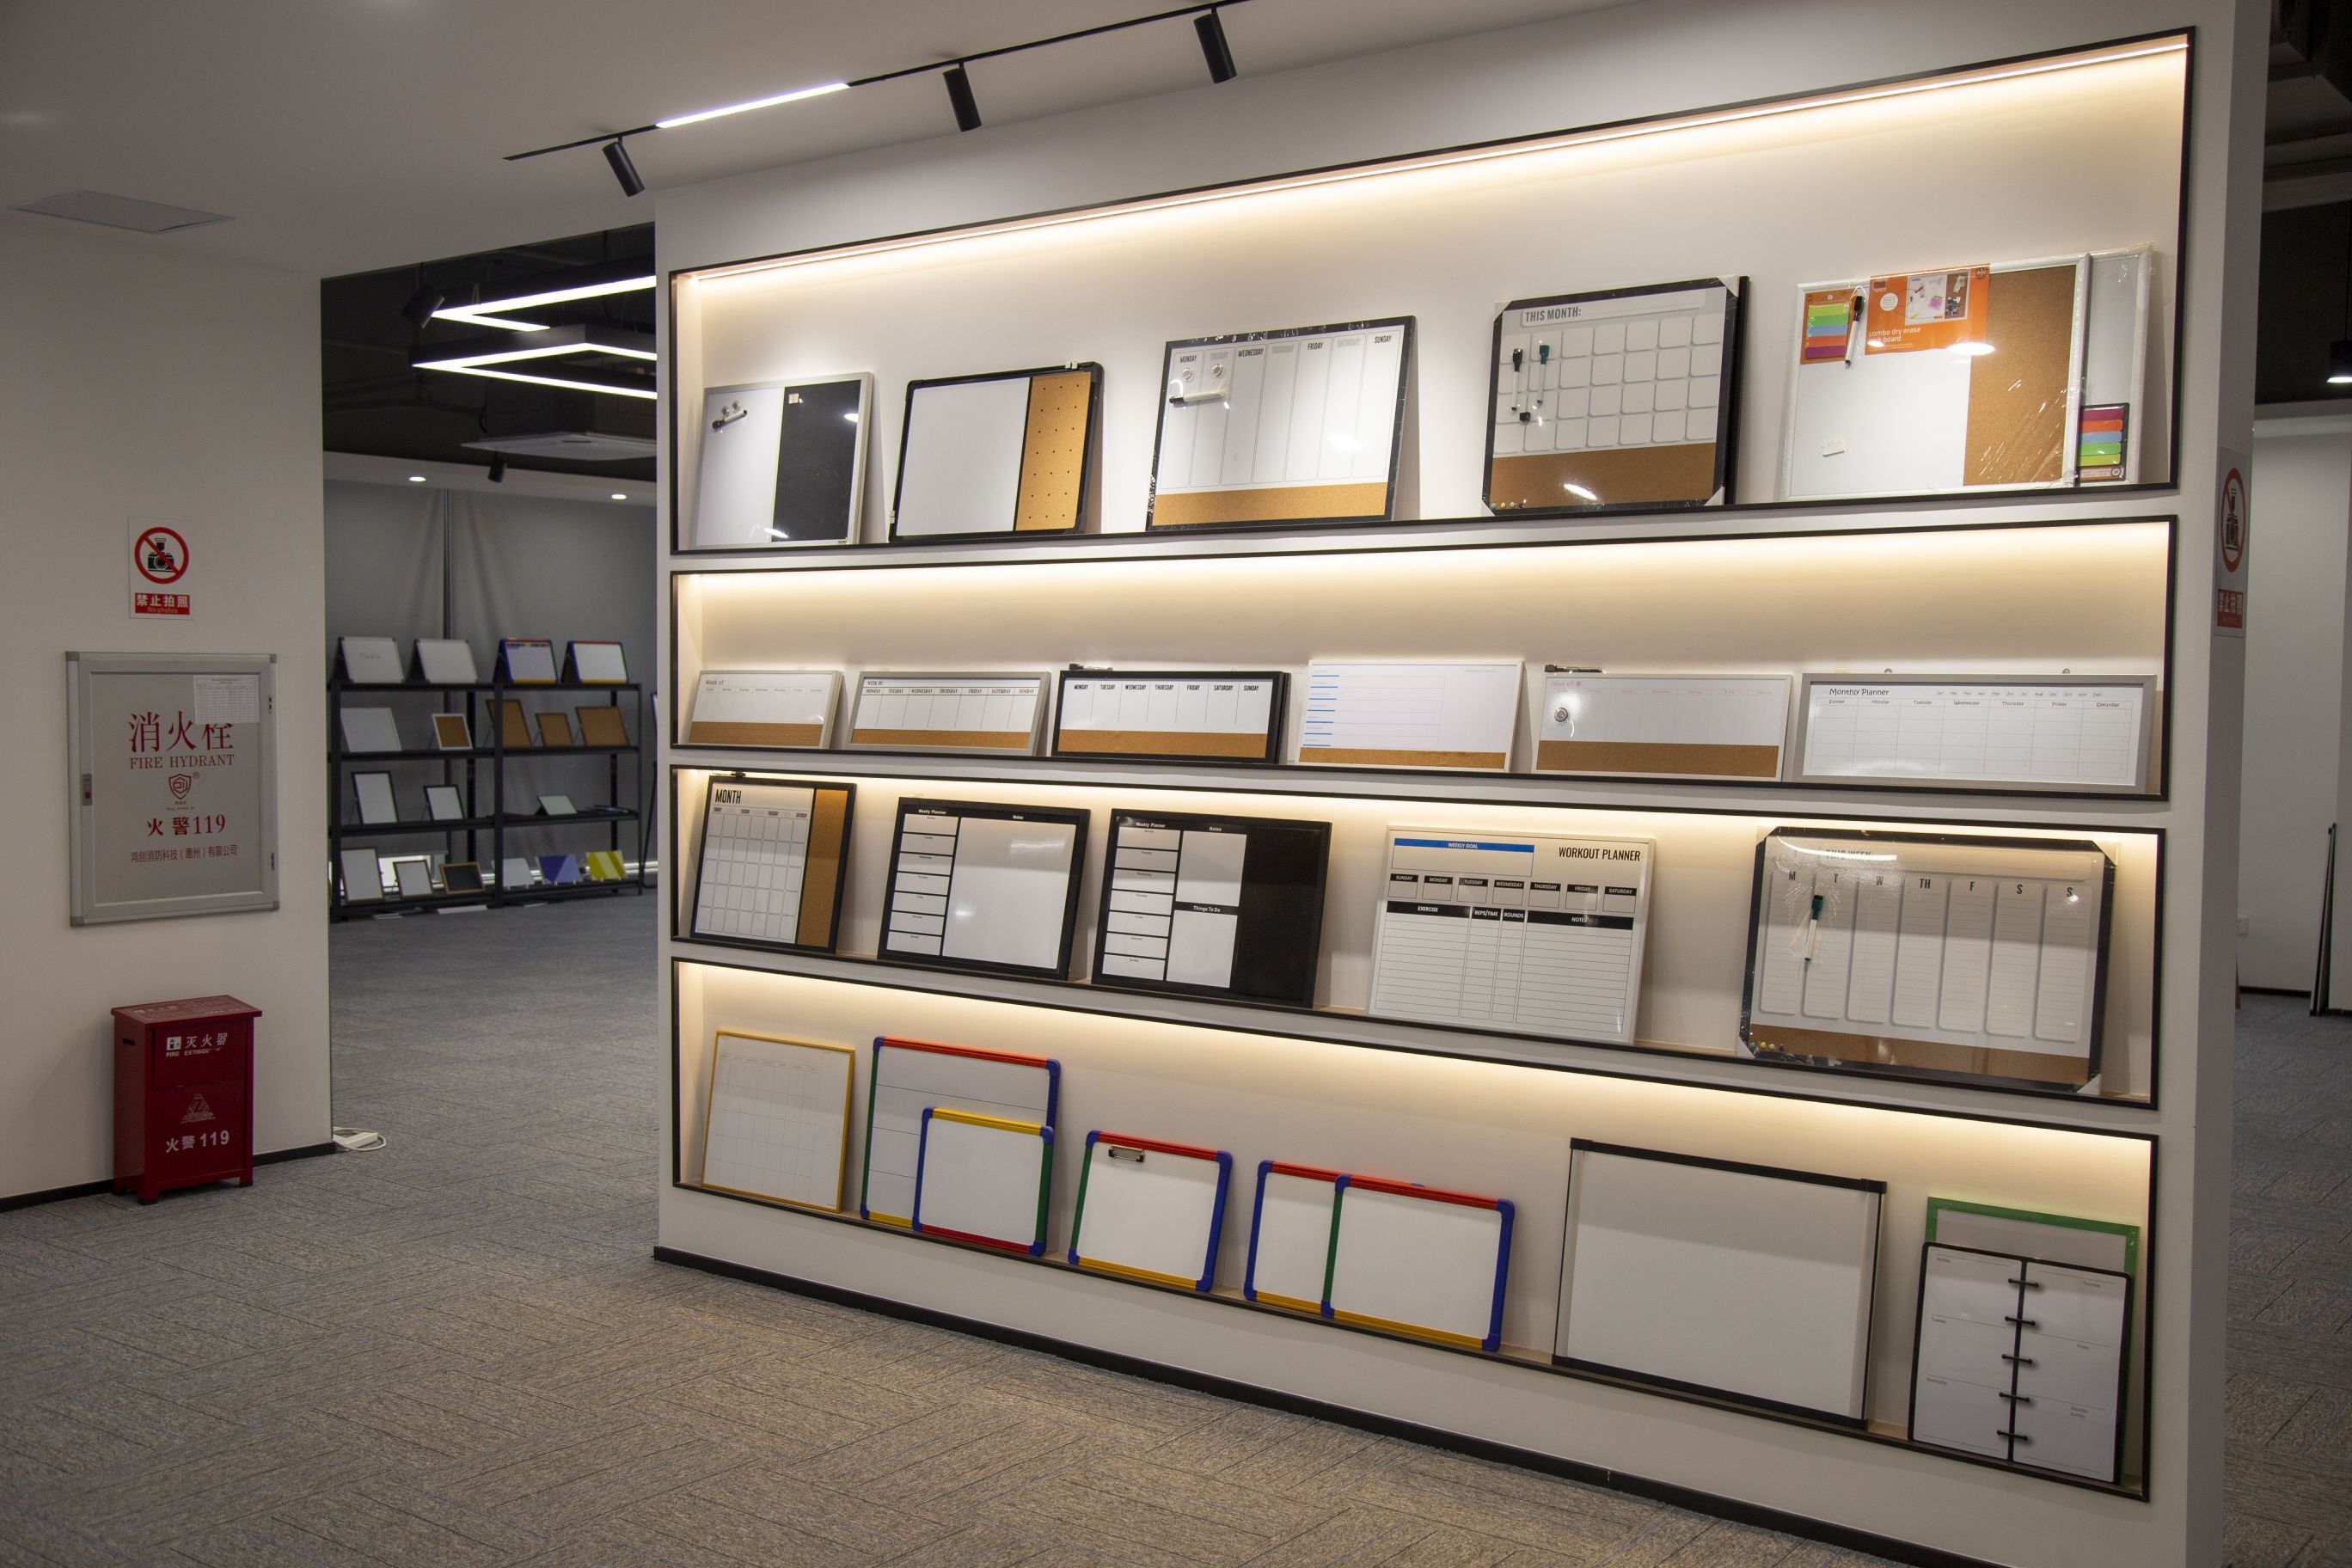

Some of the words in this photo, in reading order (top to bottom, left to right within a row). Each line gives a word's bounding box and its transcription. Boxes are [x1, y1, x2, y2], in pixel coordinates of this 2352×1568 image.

[1525, 310, 1546, 322] THIS
[1547, 306, 1582, 320] MONTH:
[1238, 348, 1264, 358] WEDNESDAY
[1308, 342, 1324, 351] FRIDAY
[1374, 335, 1392, 344] SUNDAY
[137, 594, 188, 608] 禁止拍照
[130, 756, 163, 769] FIRE
[169, 754, 235, 768] HYDRANT
[714, 788, 742, 805] MONTH
[1559, 847, 1600, 859] WORKOUT
[1602, 848, 1641, 861] PLANNER
[1788, 871, 1796, 881] M
[1834, 873, 1838, 883] T
[1877, 876, 1884, 885] W
[1919, 879, 1931, 889] TH
[1969, 881, 1975, 891] F
[2017, 884, 2023, 894] S
[2067, 886, 2073, 897] S
[185, 1032, 228, 1049] 灭火器
